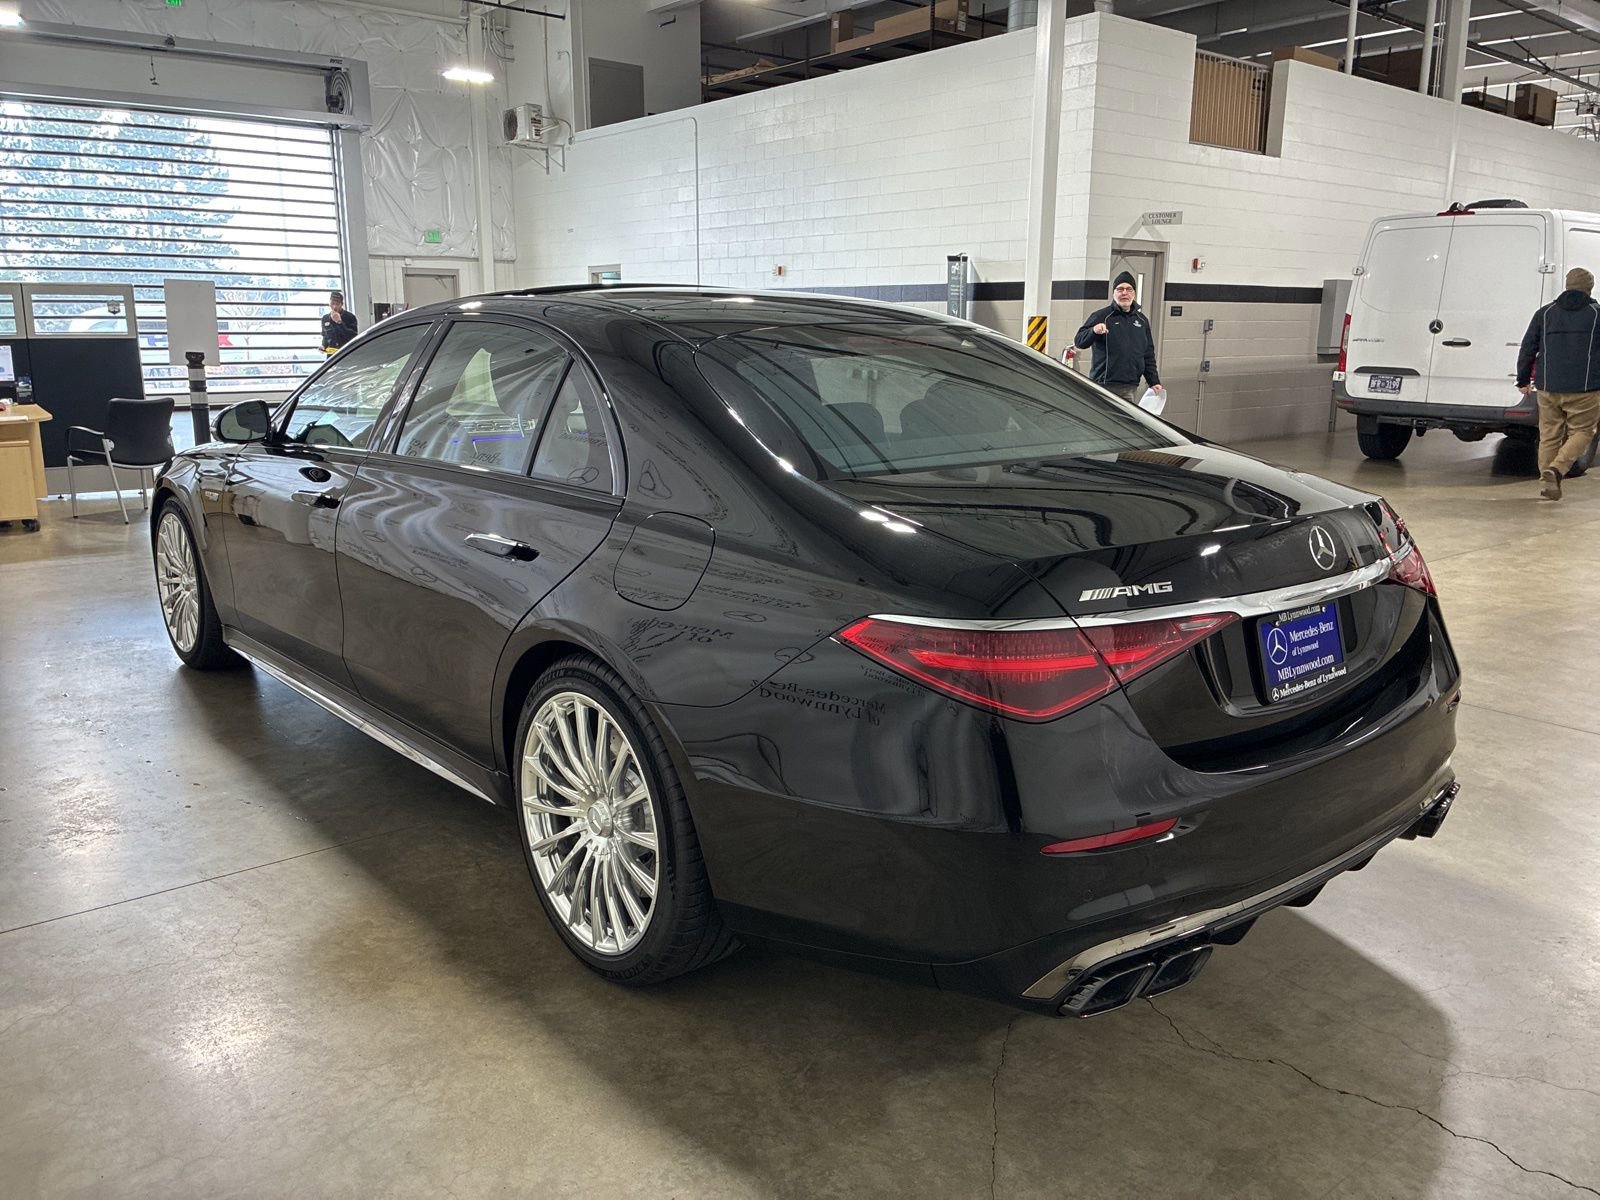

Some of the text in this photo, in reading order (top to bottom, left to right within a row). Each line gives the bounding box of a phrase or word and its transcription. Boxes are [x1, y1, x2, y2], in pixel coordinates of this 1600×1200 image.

[1110, 581, 1173, 599] AMG
[1289, 621, 1334, 643] Mercedes-Benz
[1291, 640, 1319, 657] of Lynnwood
[1277, 654, 1335, 681] MBLynnwood.com
[1279, 666, 1347, 698] Mercedes-Benz of Lynnwood
